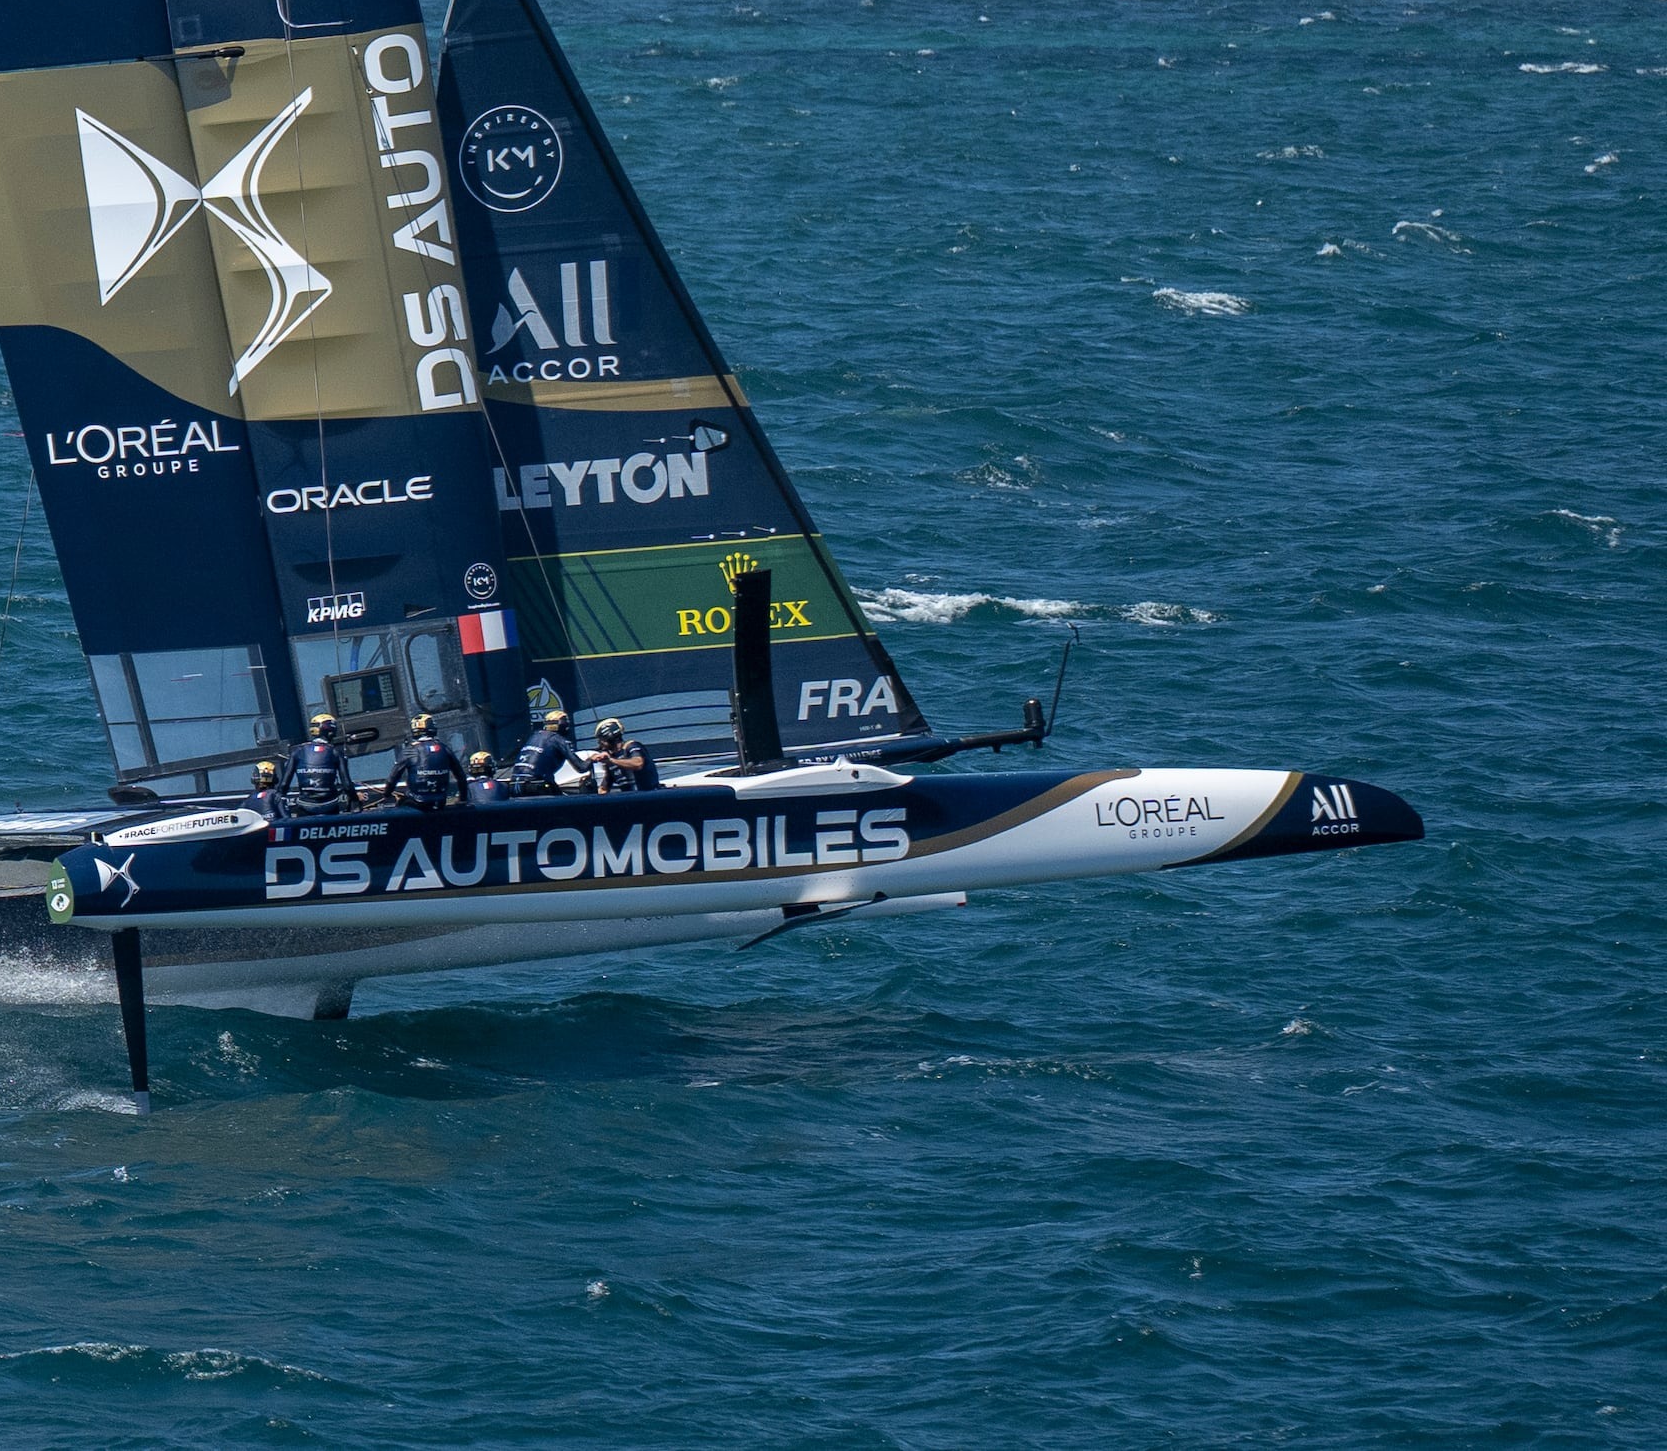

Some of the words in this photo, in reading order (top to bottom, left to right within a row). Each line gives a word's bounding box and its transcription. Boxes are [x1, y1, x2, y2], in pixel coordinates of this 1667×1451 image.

[363, 33, 455, 266] AUTO
[468, 113, 540, 165] INSPIRED
[542, 138, 556, 159] BY
[486, 145, 535, 173] KM
[403, 287, 478, 411] DS
[487, 355, 621, 386] ACCOR
[46, 419, 240, 465] L'ORÉAL
[97, 459, 200, 478] GROUPE
[494, 452, 709, 511] LEYTON
[266, 476, 435, 514] ORACLE
[307, 601, 365, 624] KPMG
[676, 599, 813, 637] ROEX
[798, 675, 899, 721] FRA
[124, 815, 230, 839] #RACEFORTHEFUTURE
[1095, 795, 1225, 827] L'ORÉAL
[299, 823, 388, 840] DELAPIERRE
[1129, 826, 1197, 839] GROUPE
[1311, 823, 1360, 836] ACCOR
[265, 840, 371, 900] DS
[386, 808, 911, 891] AUTOMOBILES
